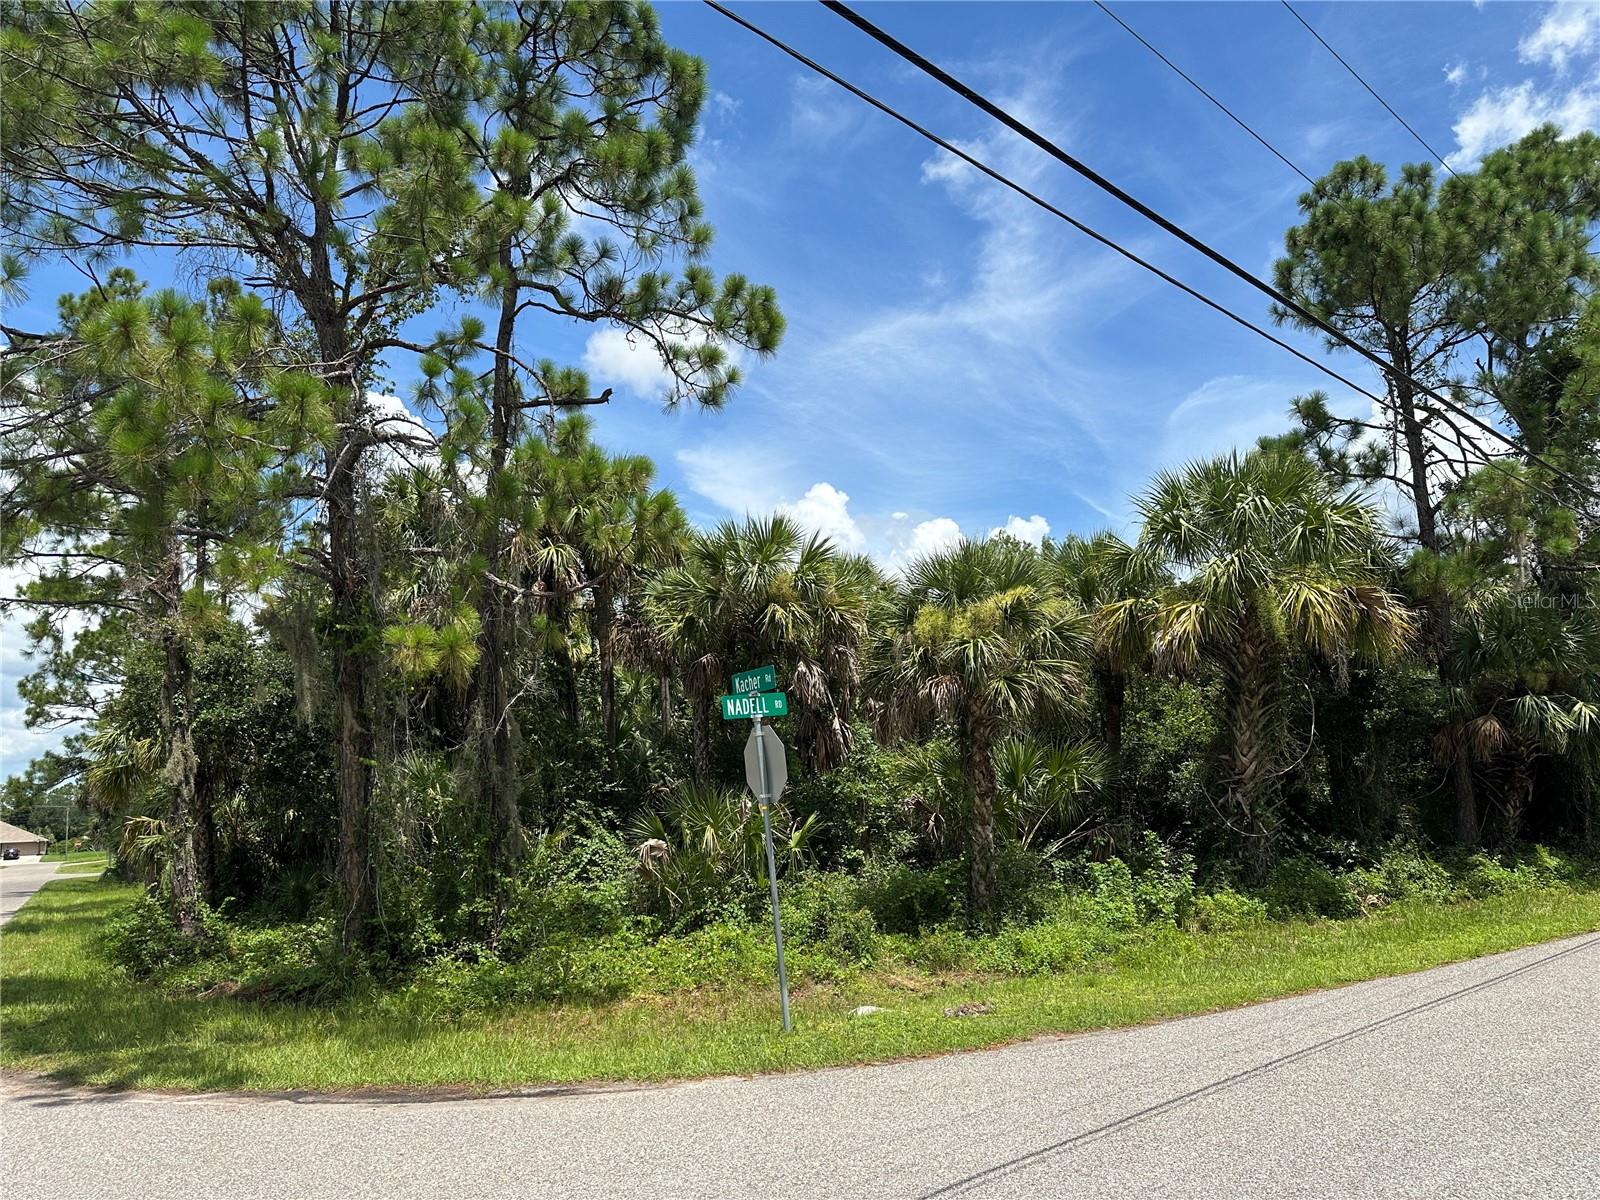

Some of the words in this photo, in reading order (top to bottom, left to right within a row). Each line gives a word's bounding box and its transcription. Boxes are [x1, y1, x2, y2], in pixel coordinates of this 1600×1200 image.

[735, 675, 760, 693] Kacher
[727, 697, 769, 715] NADELL
[774, 699, 783, 709] RD
